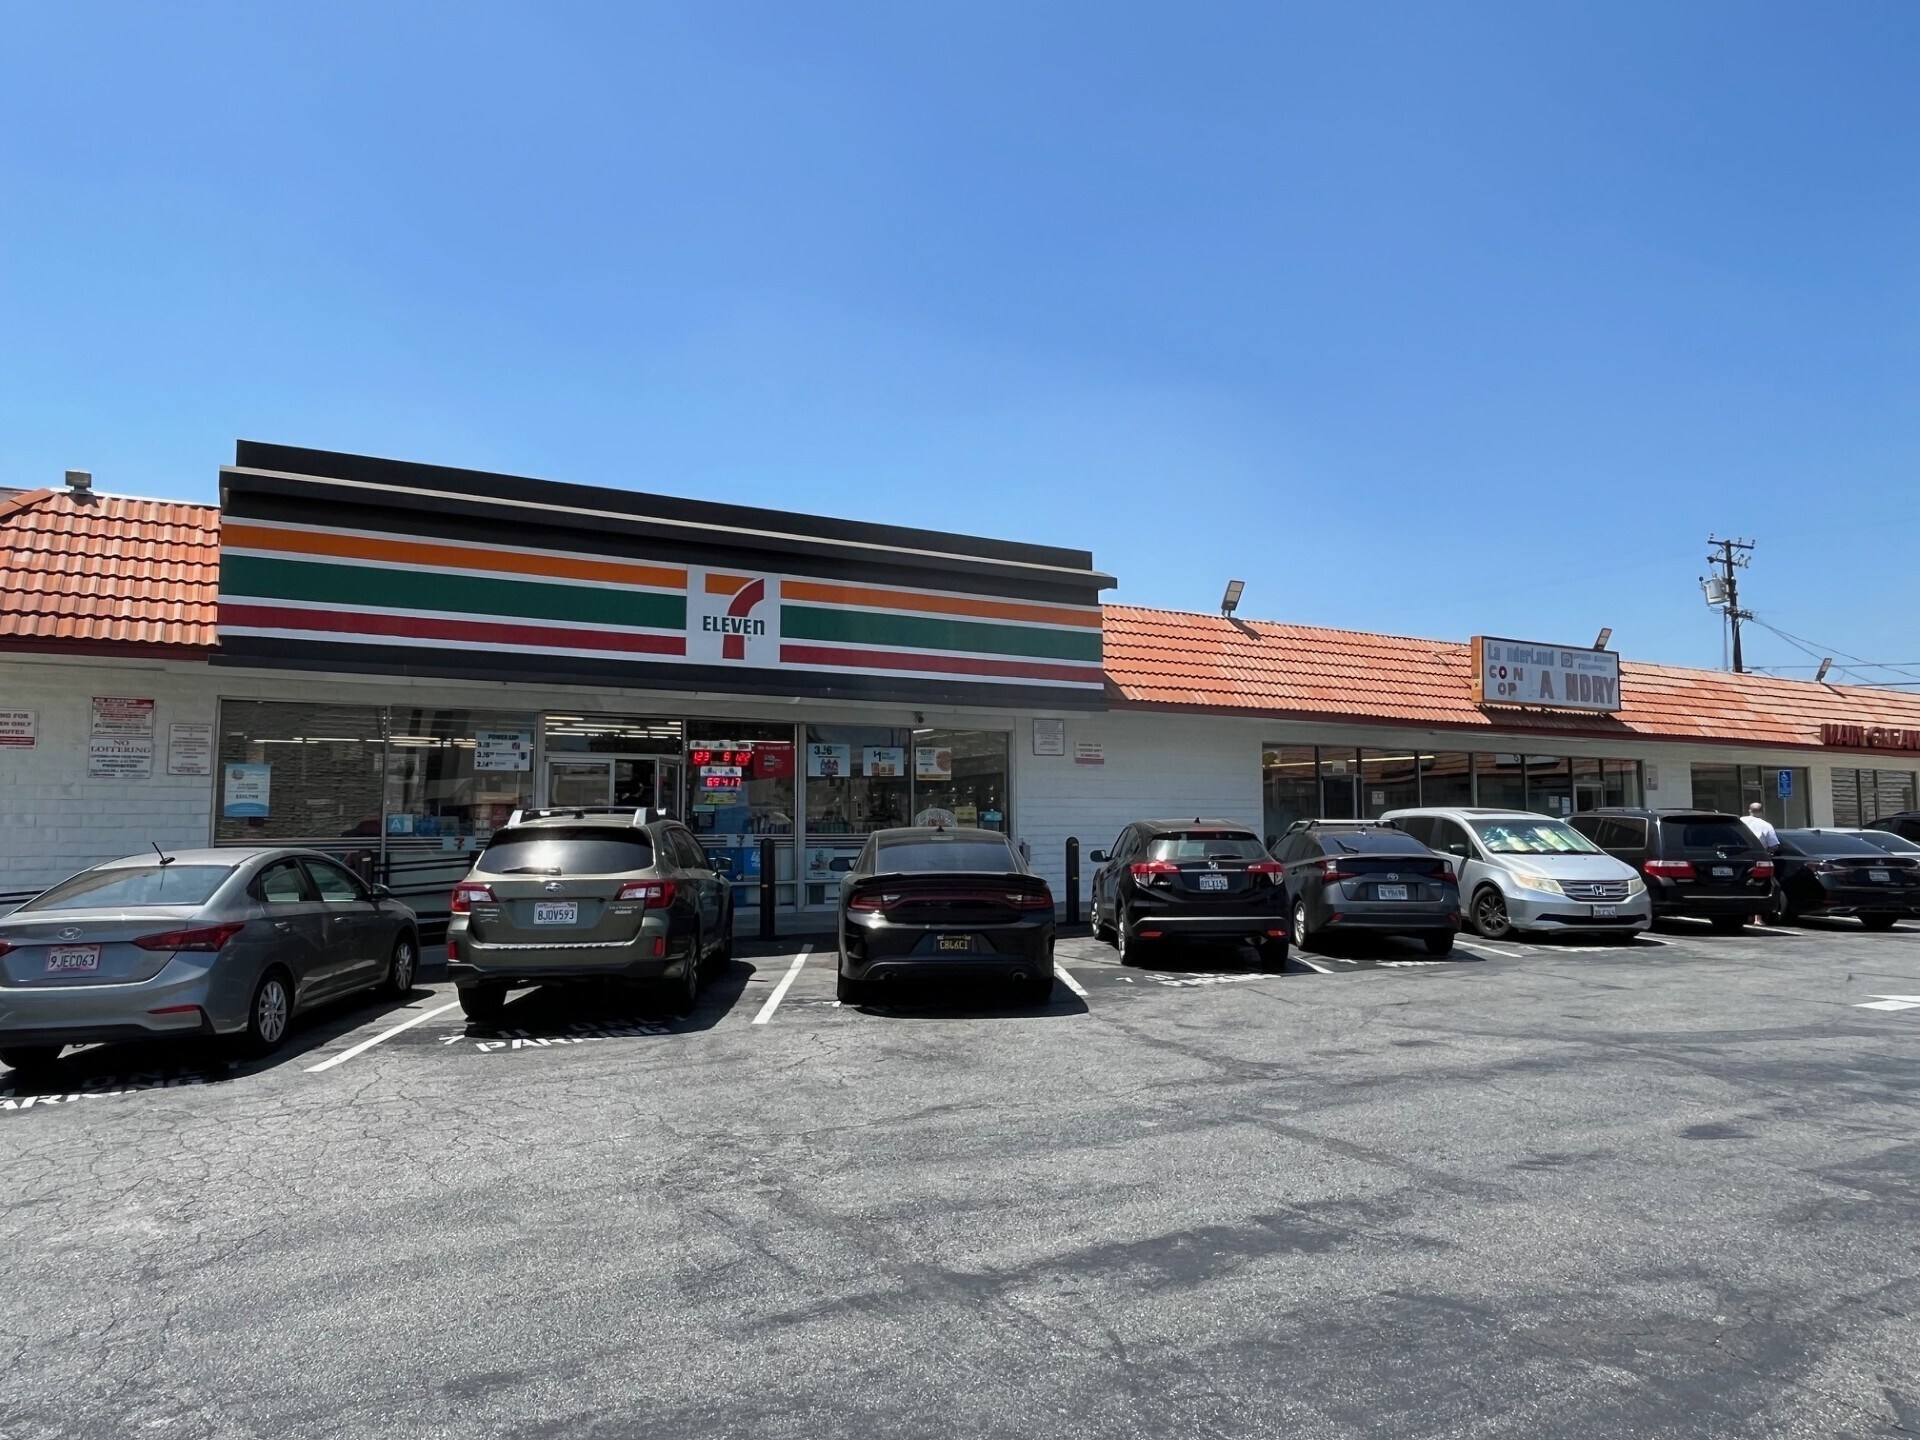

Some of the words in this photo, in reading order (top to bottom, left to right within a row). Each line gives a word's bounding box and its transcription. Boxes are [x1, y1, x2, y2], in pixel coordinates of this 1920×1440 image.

[705, 573, 764, 660] 7
[694, 752, 710, 761] 123
[391, 819, 401, 829] A
